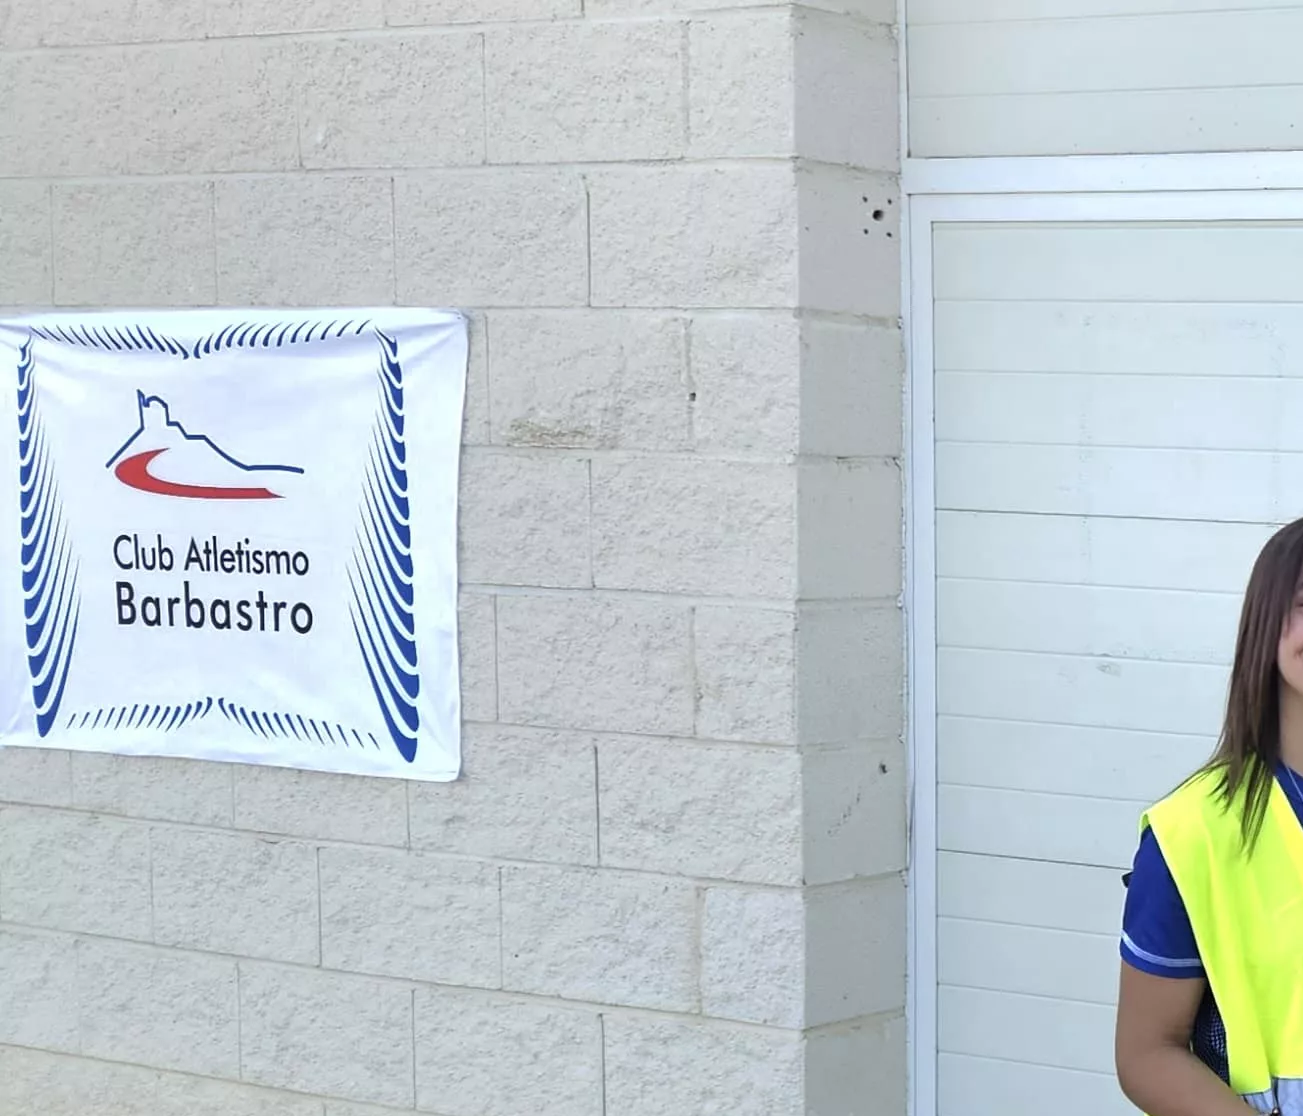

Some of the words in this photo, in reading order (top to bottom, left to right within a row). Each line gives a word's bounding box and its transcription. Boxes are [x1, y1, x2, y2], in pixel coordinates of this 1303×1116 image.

[113, 533, 174, 573] Club
[183, 535, 310, 576] Atletismo
[115, 580, 314, 635] Barbastro
